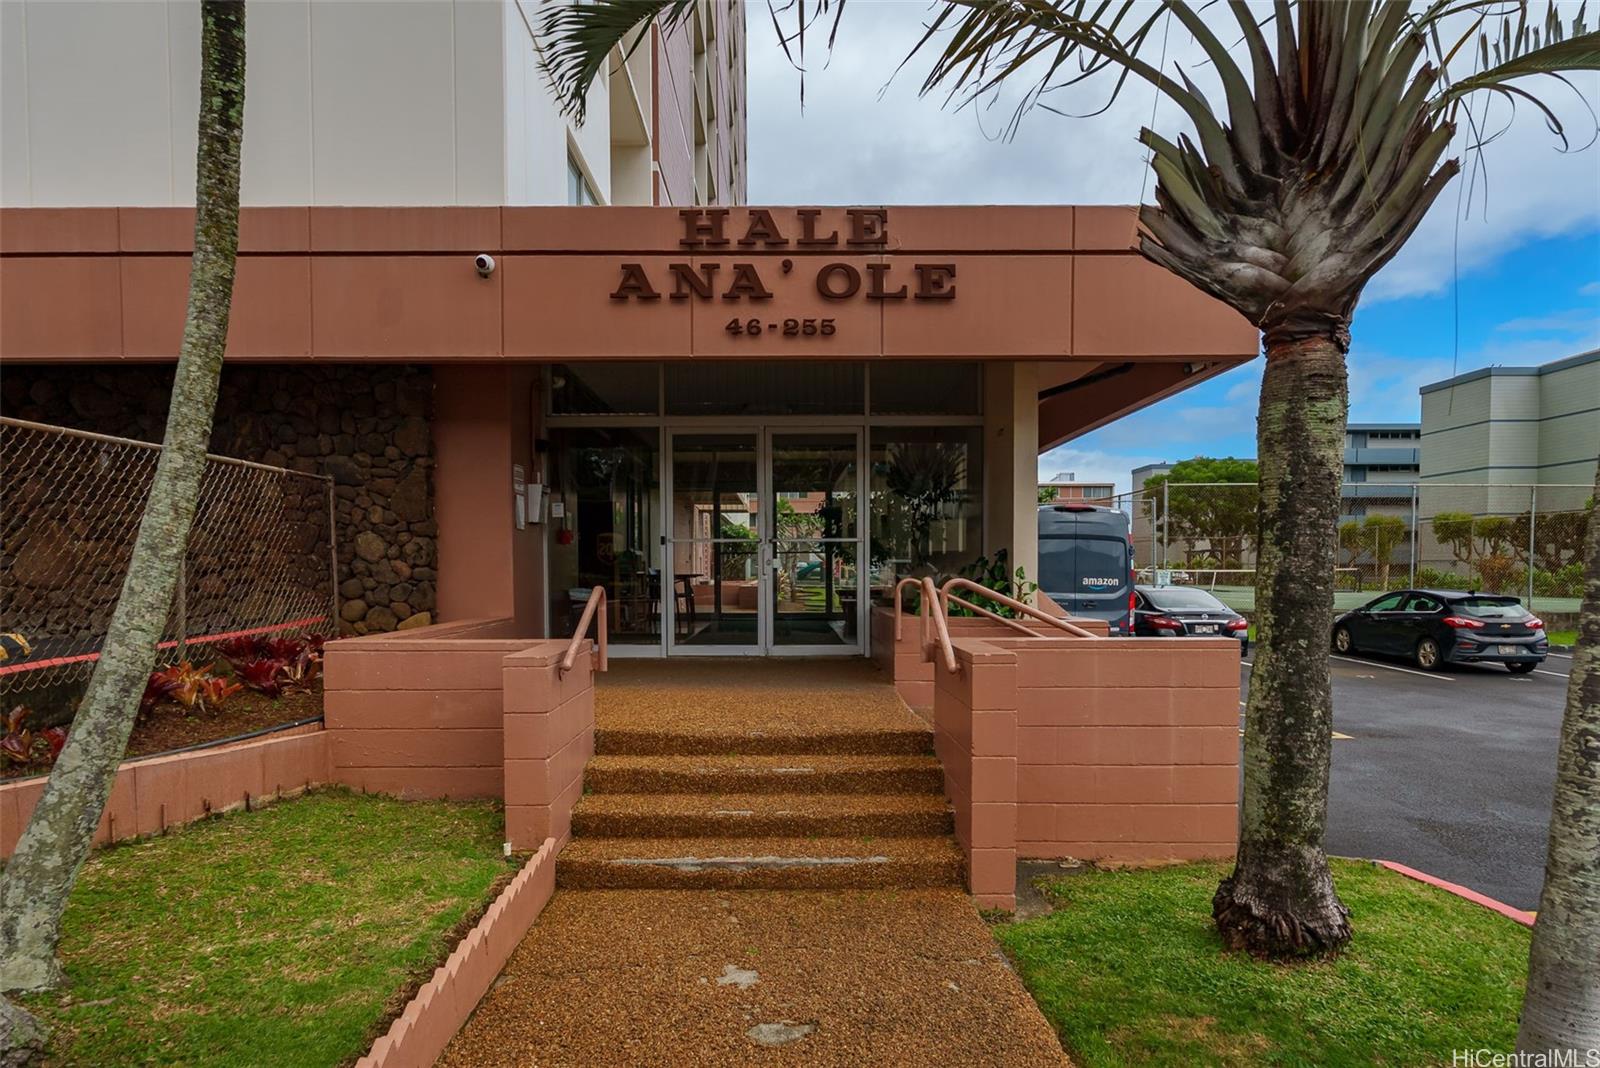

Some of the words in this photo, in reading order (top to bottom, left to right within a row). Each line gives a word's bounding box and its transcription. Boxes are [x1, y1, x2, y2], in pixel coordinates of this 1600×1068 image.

[679, 209, 889, 246] HALE
[725, 318, 836, 336] 46-255
[1082, 577, 1119, 587] amazon
